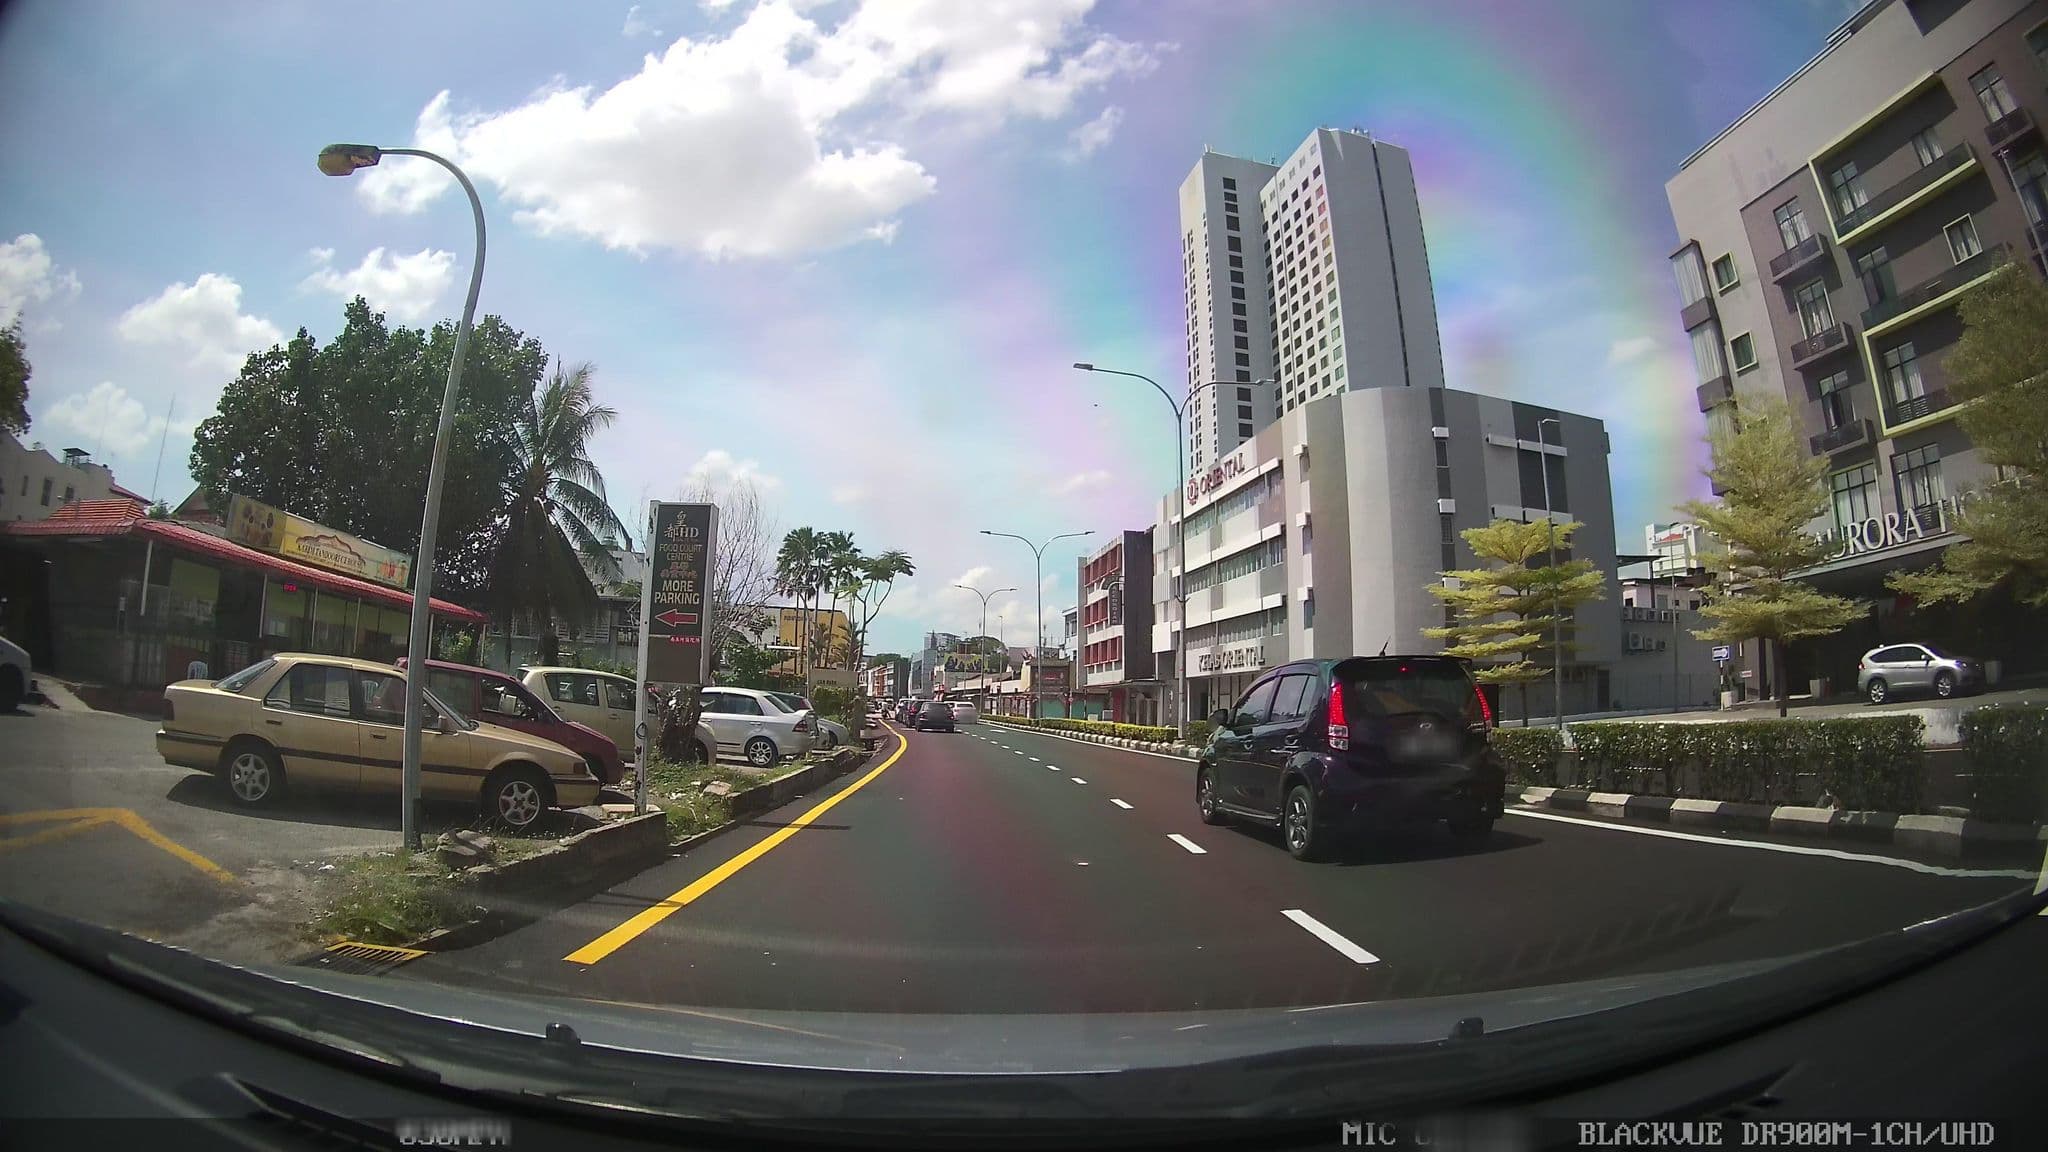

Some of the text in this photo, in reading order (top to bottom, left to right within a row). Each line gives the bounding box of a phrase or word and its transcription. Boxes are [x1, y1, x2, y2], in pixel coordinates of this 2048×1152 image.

[1200, 453, 1245, 494] ORIENTAL
[1813, 507, 1924, 559] URORA
[659, 543, 703, 553] FOOD COURT
[662, 580, 694, 592] MORE
[654, 591, 700, 605] PARKING
[1222, 646, 1266, 670] ORIENTAL
